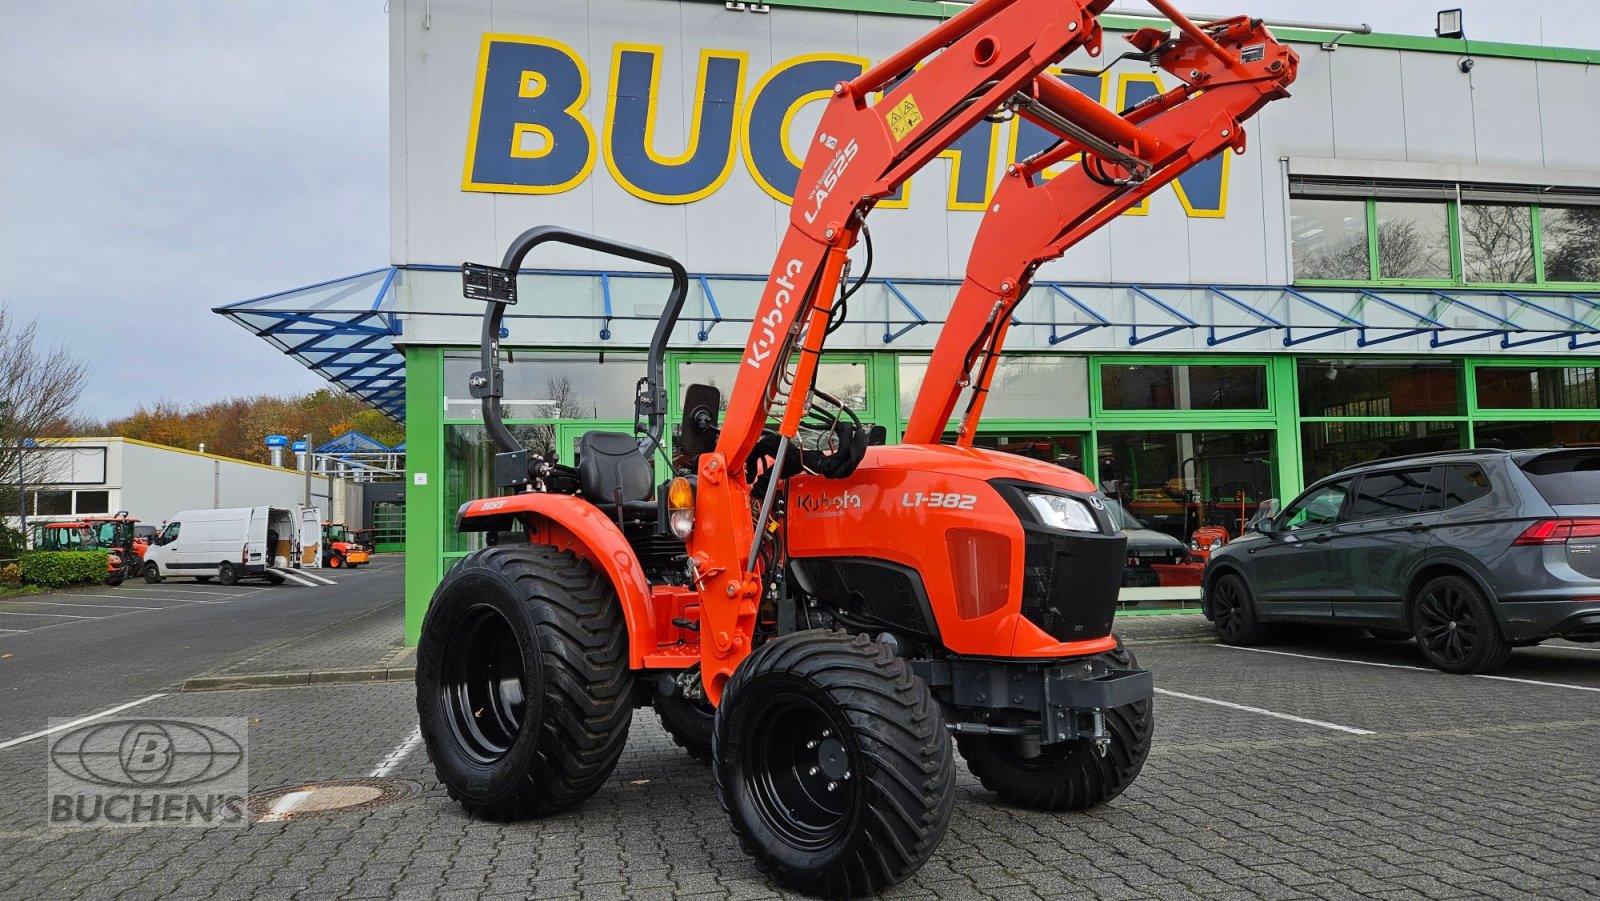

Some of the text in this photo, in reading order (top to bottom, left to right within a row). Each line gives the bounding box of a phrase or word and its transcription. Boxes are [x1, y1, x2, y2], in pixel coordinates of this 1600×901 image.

[804, 138, 858, 224] LA525
[746, 257, 804, 368] Kubota
[797, 490, 862, 512] Kubota
[902, 492, 977, 510] L1-382
